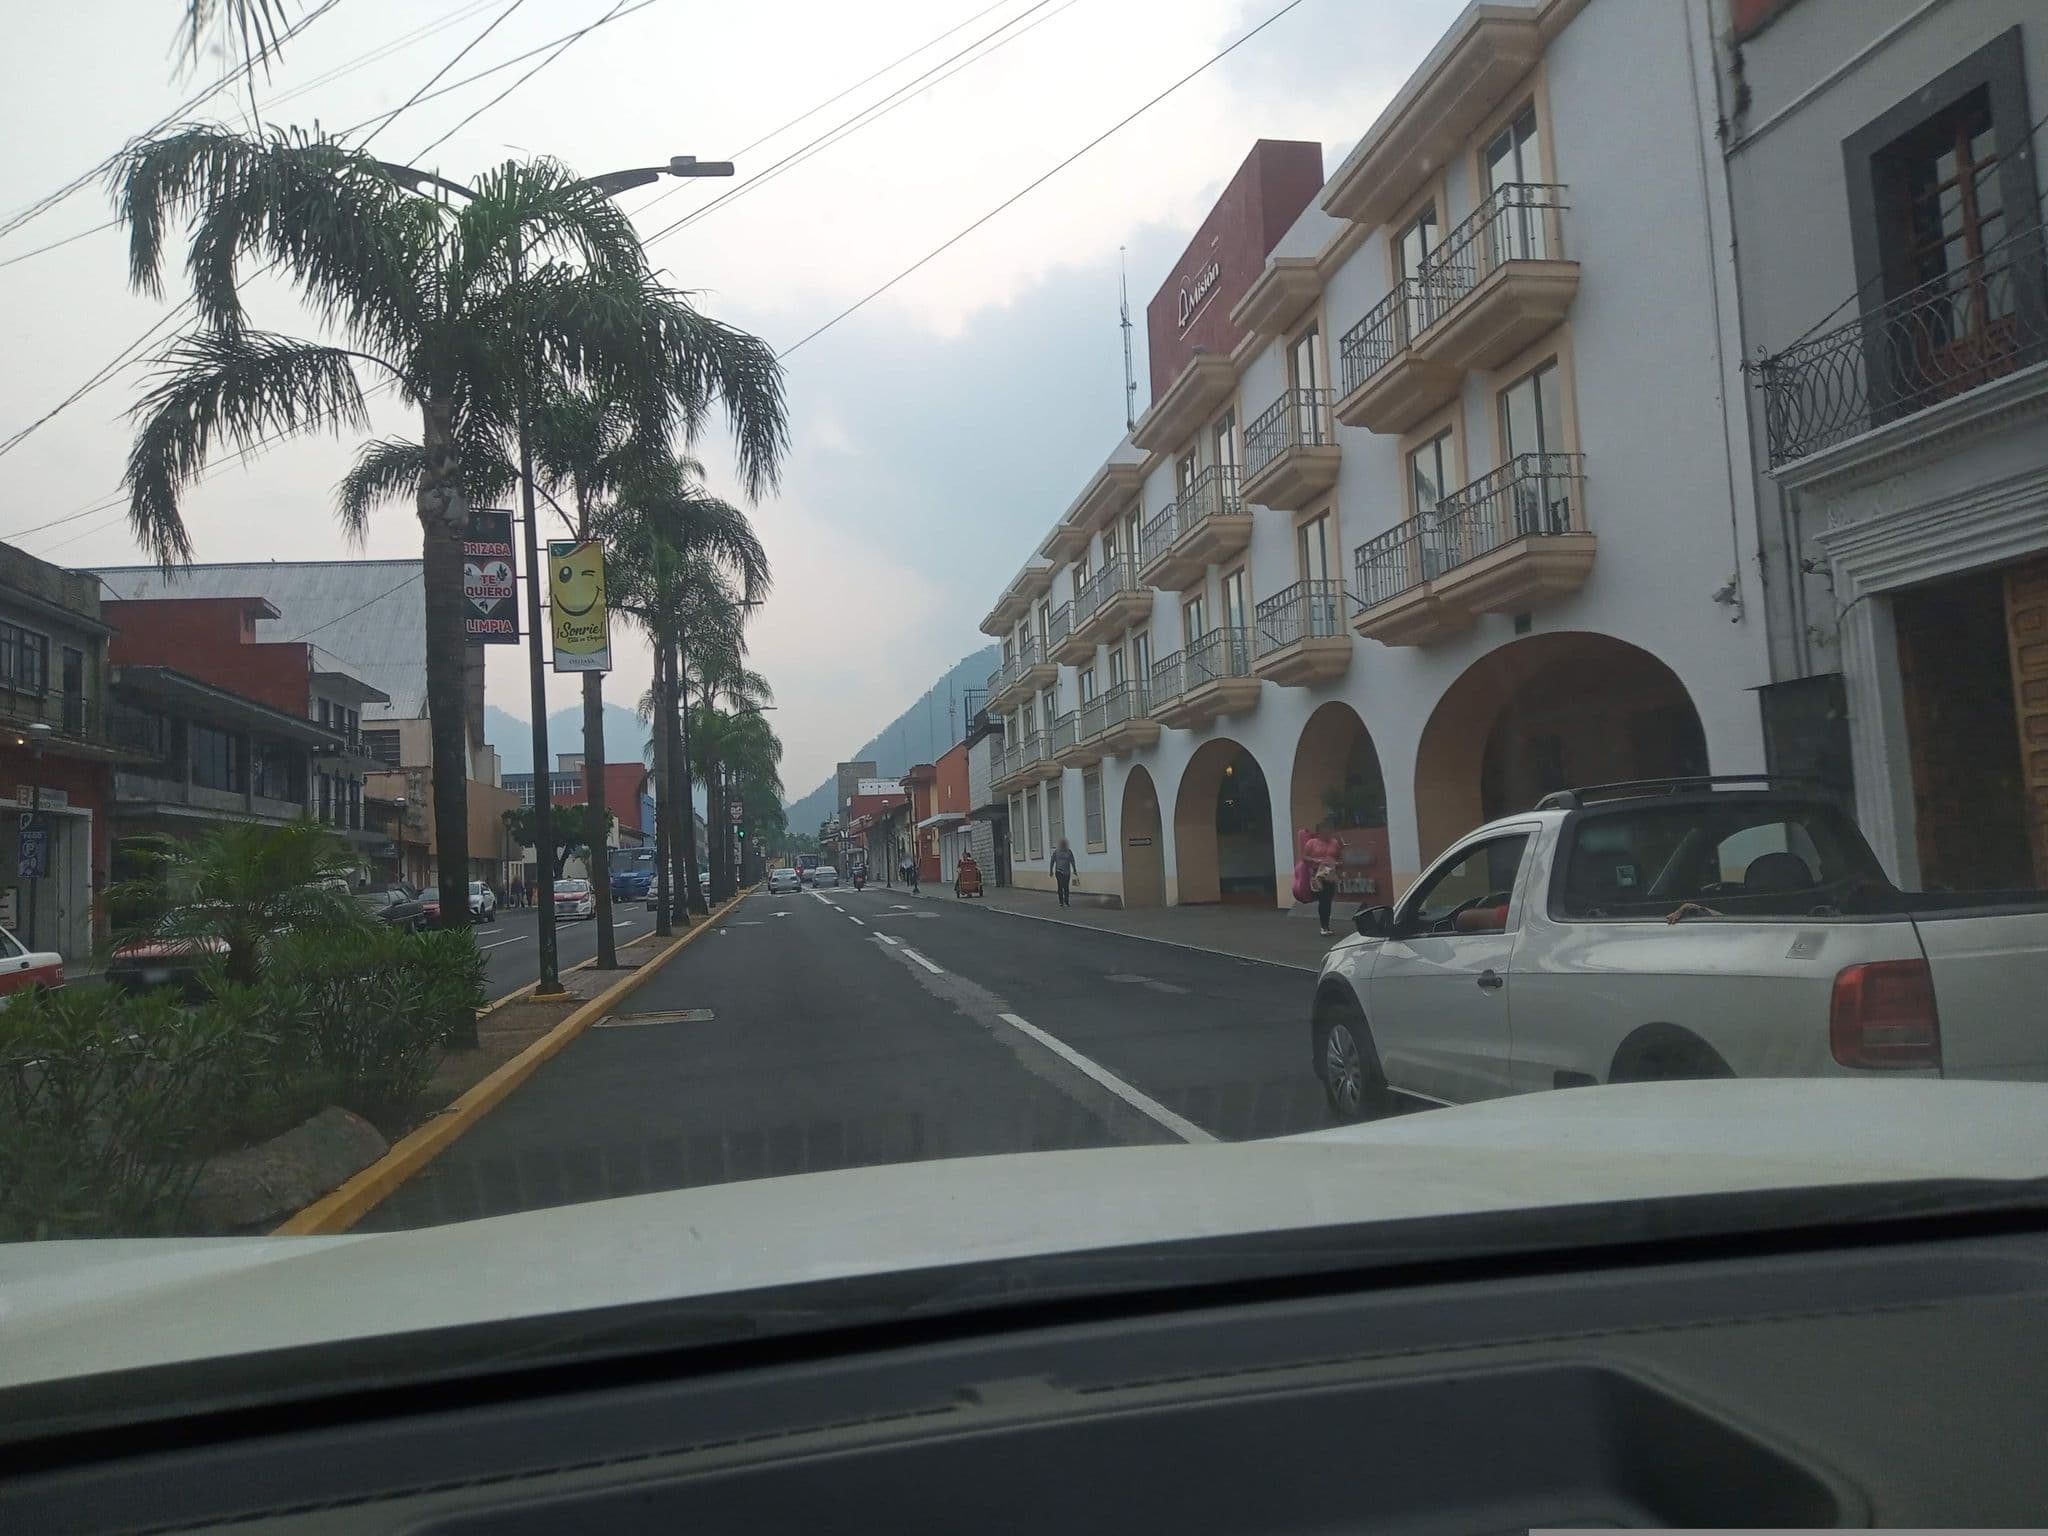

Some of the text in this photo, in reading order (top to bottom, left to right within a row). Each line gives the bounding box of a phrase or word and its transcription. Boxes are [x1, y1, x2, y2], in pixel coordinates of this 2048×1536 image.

[1188, 263, 1219, 312] Misión
[480, 574, 497, 586] TE
[465, 586, 512, 598] QUIERO
[466, 619, 513, 633] LIMPIA
